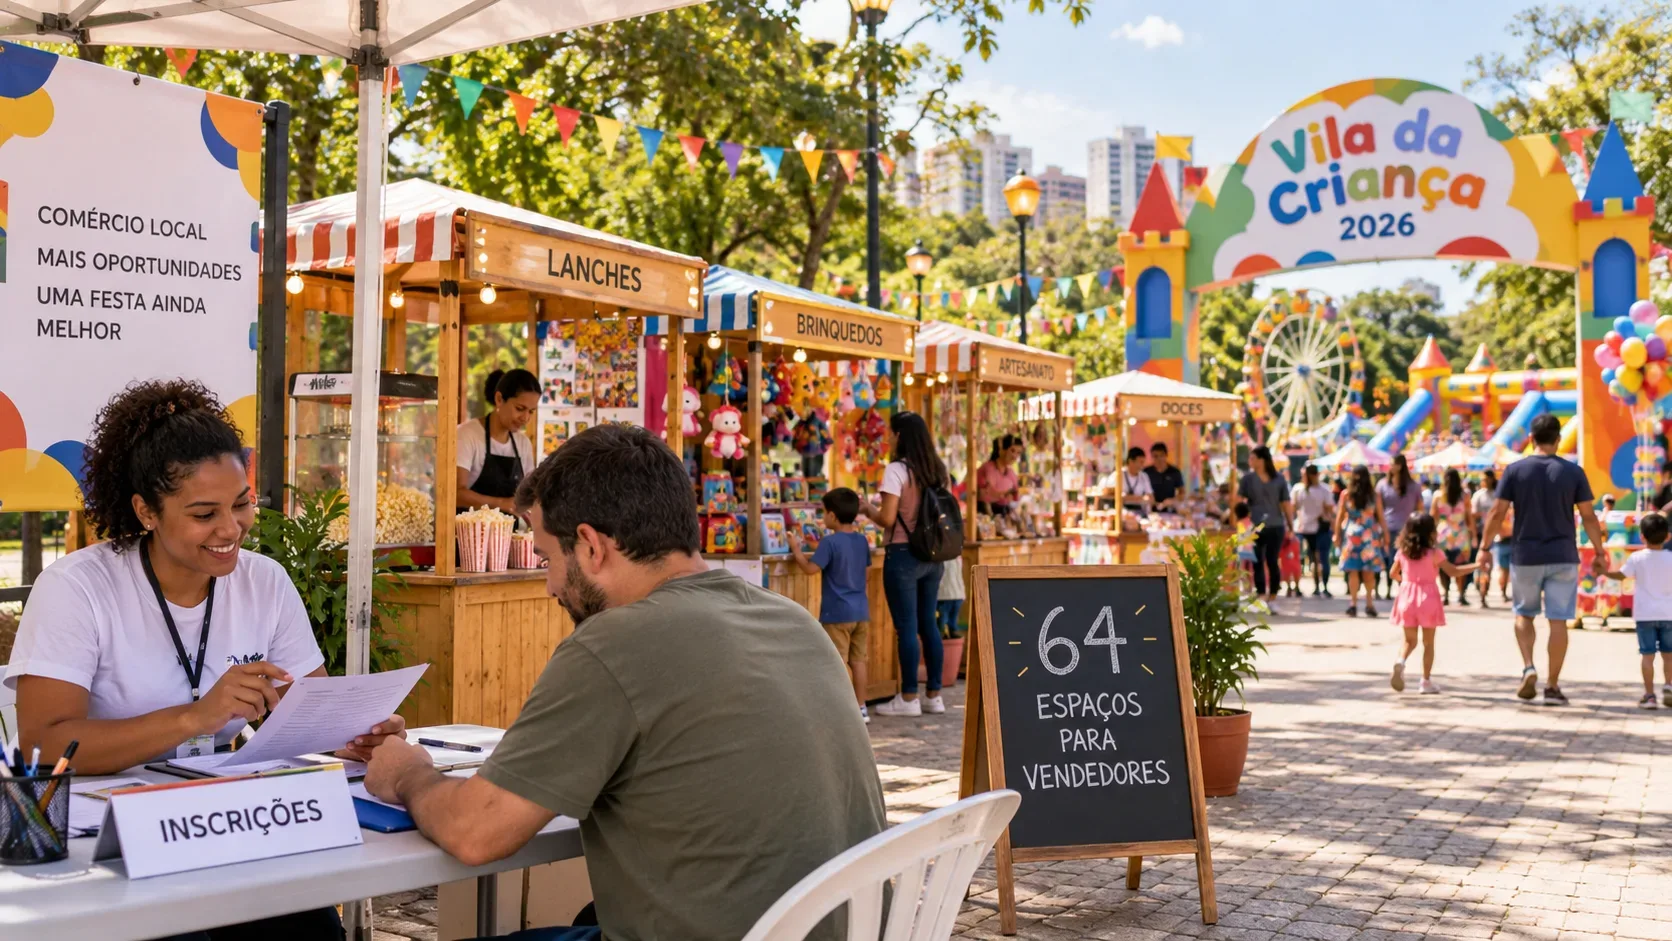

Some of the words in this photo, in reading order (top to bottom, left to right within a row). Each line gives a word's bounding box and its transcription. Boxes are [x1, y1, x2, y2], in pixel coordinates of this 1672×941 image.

[1270, 116, 1376, 174] Vila
[1393, 108, 1462, 158] da
[1268, 162, 1486, 225] Criança
[37, 205, 145, 234] COMÉRCIO
[150, 218, 207, 241] LOCAL
[1340, 212, 1416, 241] 2026
[37, 247, 87, 269] MAIS
[92, 252, 242, 281] OPORTUNIDADES
[547, 248, 642, 293] LANCHES
[37, 286, 84, 307] UMA
[90, 289, 147, 311] FESTA
[151, 294, 206, 314] AINDA
[37, 318, 121, 340] MELHOR
[796, 312, 884, 347] BRINQUEDOS
[998, 357, 1055, 382] ARTESANATO
[1160, 401, 1204, 416] DOCES
[1038, 605, 1127, 676] 64
[1036, 691, 1143, 722] ESPAÇOS
[1059, 728, 1117, 752] PARA
[1022, 759, 1171, 790] VENDEDORES
[159, 798, 323, 843] INSCRIÇÕES
